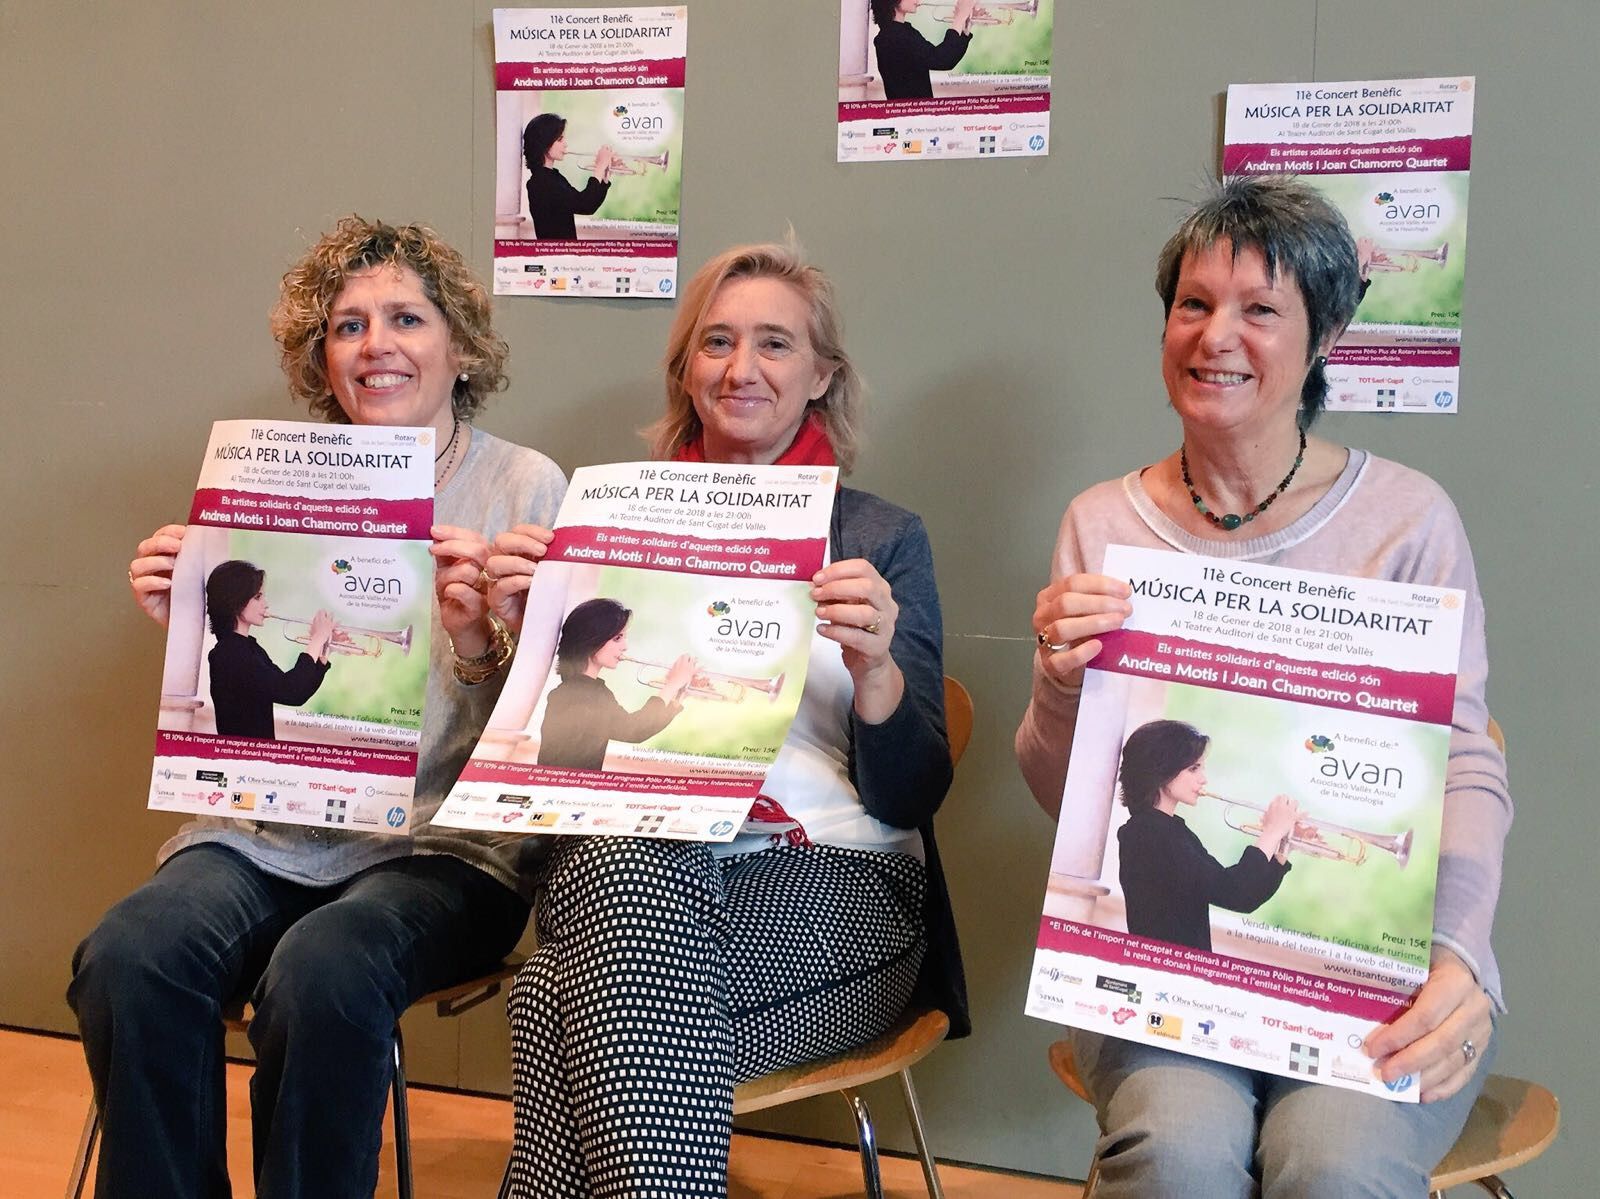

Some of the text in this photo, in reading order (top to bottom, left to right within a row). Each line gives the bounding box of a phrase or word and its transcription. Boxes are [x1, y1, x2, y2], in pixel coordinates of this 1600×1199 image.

[550, 15, 563, 24] 11è
[565, 14, 599, 24] Concert
[602, 14, 632, 23] Benèfic
[510, 26, 672, 39] MÚSICA PER LA SOLIDARITAT
[513, 77, 543, 86] Andrea
[544, 77, 567, 86] Motis
[573, 77, 593, 86] Joan
[594, 76, 634, 85] Chamorro
[635, 75, 668, 85] Quartet
[1296, 87, 1401, 100] 11è Concert Benèfic
[1244, 100, 1453, 118] MÚSICA PER LA SOLIDARITAT
[621, 116, 663, 129] avan
[1029, 135, 1044, 150] hp
[1244, 160, 1281, 171] Andrea
[1284, 160, 1313, 170] Motis
[1321, 160, 1346, 170] Joan
[1349, 158, 1403, 169] Chamorro
[1405, 157, 1448, 168] Quartet
[1385, 203, 1440, 219] avan
[659, 279, 672, 293] hp
[1435, 391, 1452, 407] hp
[251, 428, 263, 440] 11è
[266, 428, 306, 443] Concert
[310, 431, 352, 445] Benèfic
[394, 434, 416, 442] Rotary
[214, 444, 412, 468] MÚSICA PER LA SOLIDARITAT
[639, 469, 756, 485] 11è Concert Benèfic
[798, 473, 819, 483] Rotary
[581, 483, 812, 508] MÚSICA PER LA SOLIDARITAT
[221, 495, 378, 515] Els artistes solidaris d'aquesta edició són
[198, 509, 230, 522] Andrea
[233, 511, 263, 525] Motis
[272, 514, 298, 527] Joan
[301, 516, 358, 531] Chamorro
[361, 520, 407, 533] Quartet
[596, 532, 769, 555] Els artistes solidaris d'aquesta edició són
[563, 545, 606, 559] Andrea
[608, 548, 643, 562] Motis
[652, 552, 681, 566] Joan
[685, 555, 746, 572] Chamorro
[749, 560, 796, 574] Quartet
[344, 575, 402, 594] avan
[1203, 567, 1355, 600] 11è Concert Benèfic
[1127, 577, 1206, 604] MÚSICA
[1214, 591, 1250, 611] PER
[1258, 597, 1283, 616] LA
[1290, 602, 1432, 635] SOLIDARITAT
[1411, 592, 1440, 605] Rotary
[717, 617, 781, 640] avan
[1193, 610, 1204, 620] 18
[1206, 613, 1218, 622] de
[1220, 614, 1250, 626] Gener
[1252, 619, 1265, 629] de
[1267, 621, 1292, 632] 2018
[1303, 626, 1315, 636] les
[1318, 628, 1352, 641] 21:00h
[1170, 619, 1373, 656] Al Teatre Auditori de Sant Cugat del Vallès
[1157, 642, 1380, 686] Els artistes solidaris d'aquesta edició són
[1118, 653, 1171, 674] Andrea
[1175, 662, 1218, 681] Motis
[1230, 671, 1267, 689] Joan
[1271, 678, 1351, 703] Chamorro
[1355, 691, 1418, 713] Quartet
[1333, 732, 1341, 741] A
[1343, 734, 1377, 746] benefici
[1319, 754, 1404, 789] avan
[387, 806, 406, 827] hp
[710, 821, 732, 837] hp
[1123, 948, 1131, 957] la
[1132, 952, 1151, 962] resta
[1163, 958, 1191, 971] donarà
[1250, 976, 1281, 991] l'entitat
